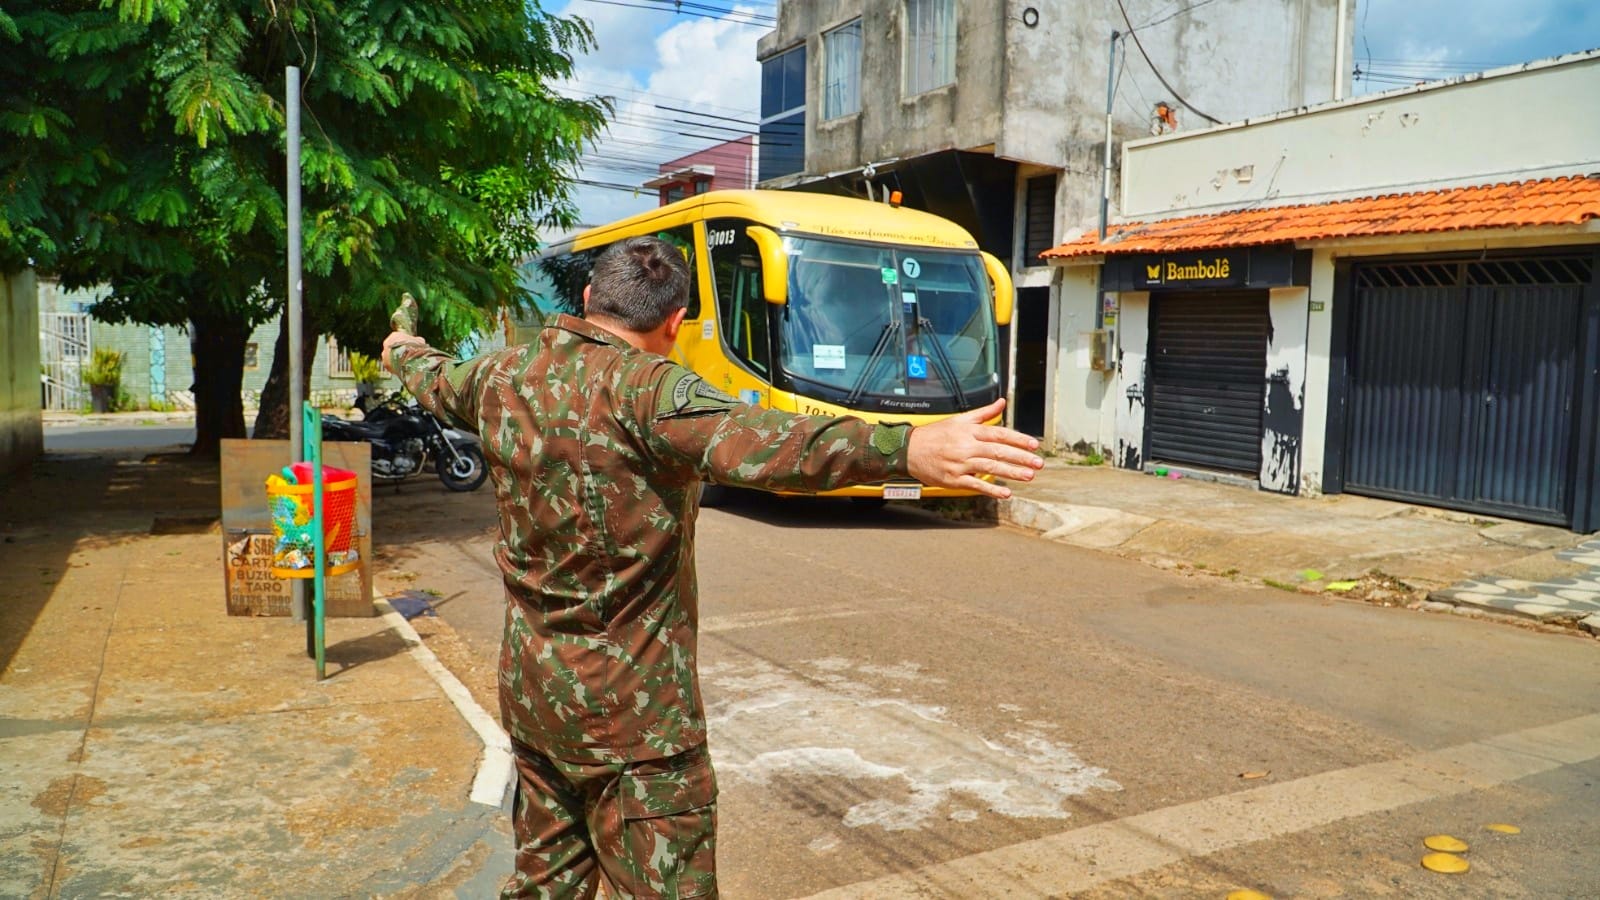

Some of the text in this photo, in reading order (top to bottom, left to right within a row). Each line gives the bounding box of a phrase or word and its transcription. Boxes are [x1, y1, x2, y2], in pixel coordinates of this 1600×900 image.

[715, 229, 736, 246] 1013
[906, 261, 916, 276] 7
[1167, 258, 1230, 281] Bambolê
[676, 378, 692, 399] SELVA
[880, 399, 930, 409] Marcopolo
[231, 557, 274, 568] CART
[236, 570, 287, 581] BUZIO
[245, 582, 282, 593] TARO
